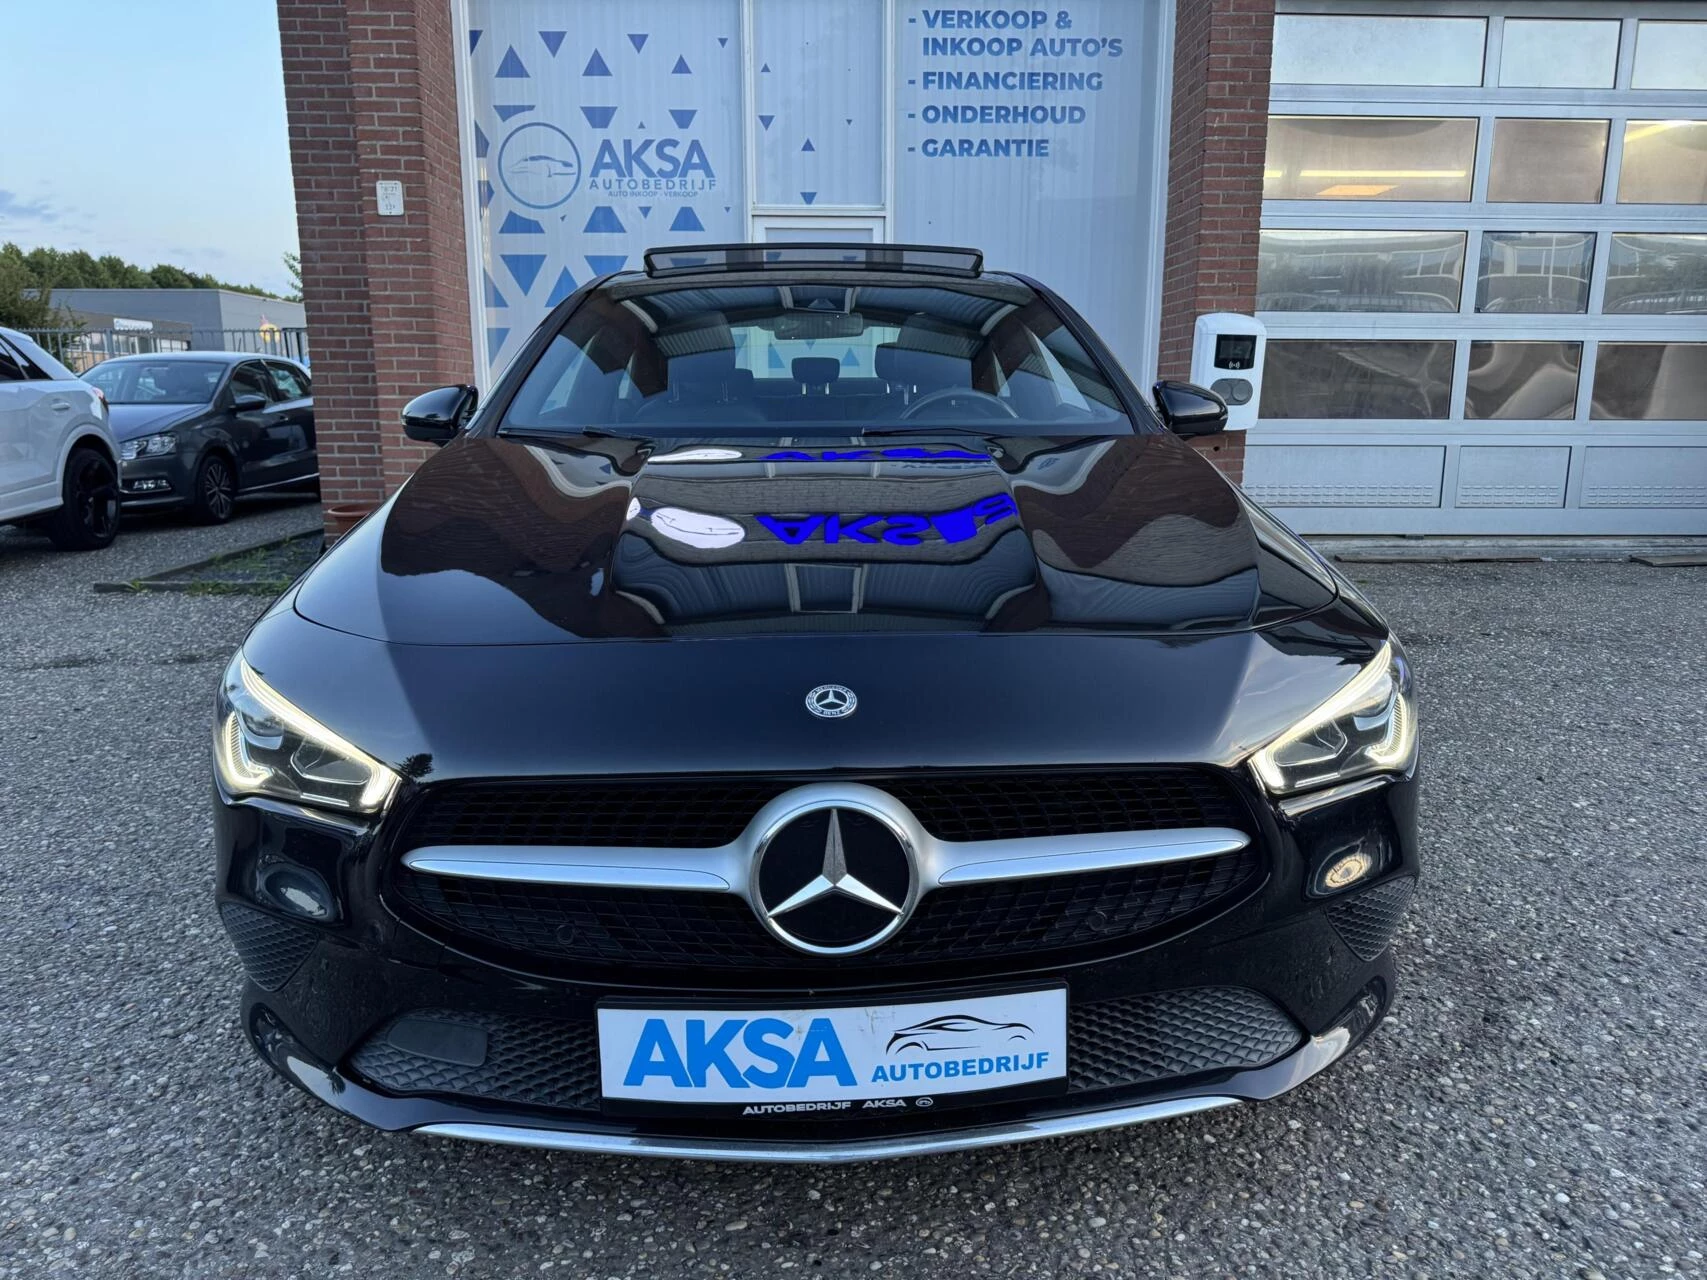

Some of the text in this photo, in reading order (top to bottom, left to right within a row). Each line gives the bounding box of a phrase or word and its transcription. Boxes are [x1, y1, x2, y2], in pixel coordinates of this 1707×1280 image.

[922, 10, 1047, 29] VERKOOP
[1055, 11, 1072, 29] &
[923, 37, 1123, 57] INKOOP AUTO’S
[922, 71, 1103, 91] FINANCIERING
[922, 105, 1086, 124] ONDERHOUD
[922, 138, 1049, 157] GARANTIE
[589, 138, 715, 179] AKSA
[589, 180, 716, 190] AUTOBEDRIJF
[623, 1018, 1049, 1089] AKSA AUTOBEDRIJF
[742, 1098, 907, 1116] AUTOBEDRIJF AKSA
